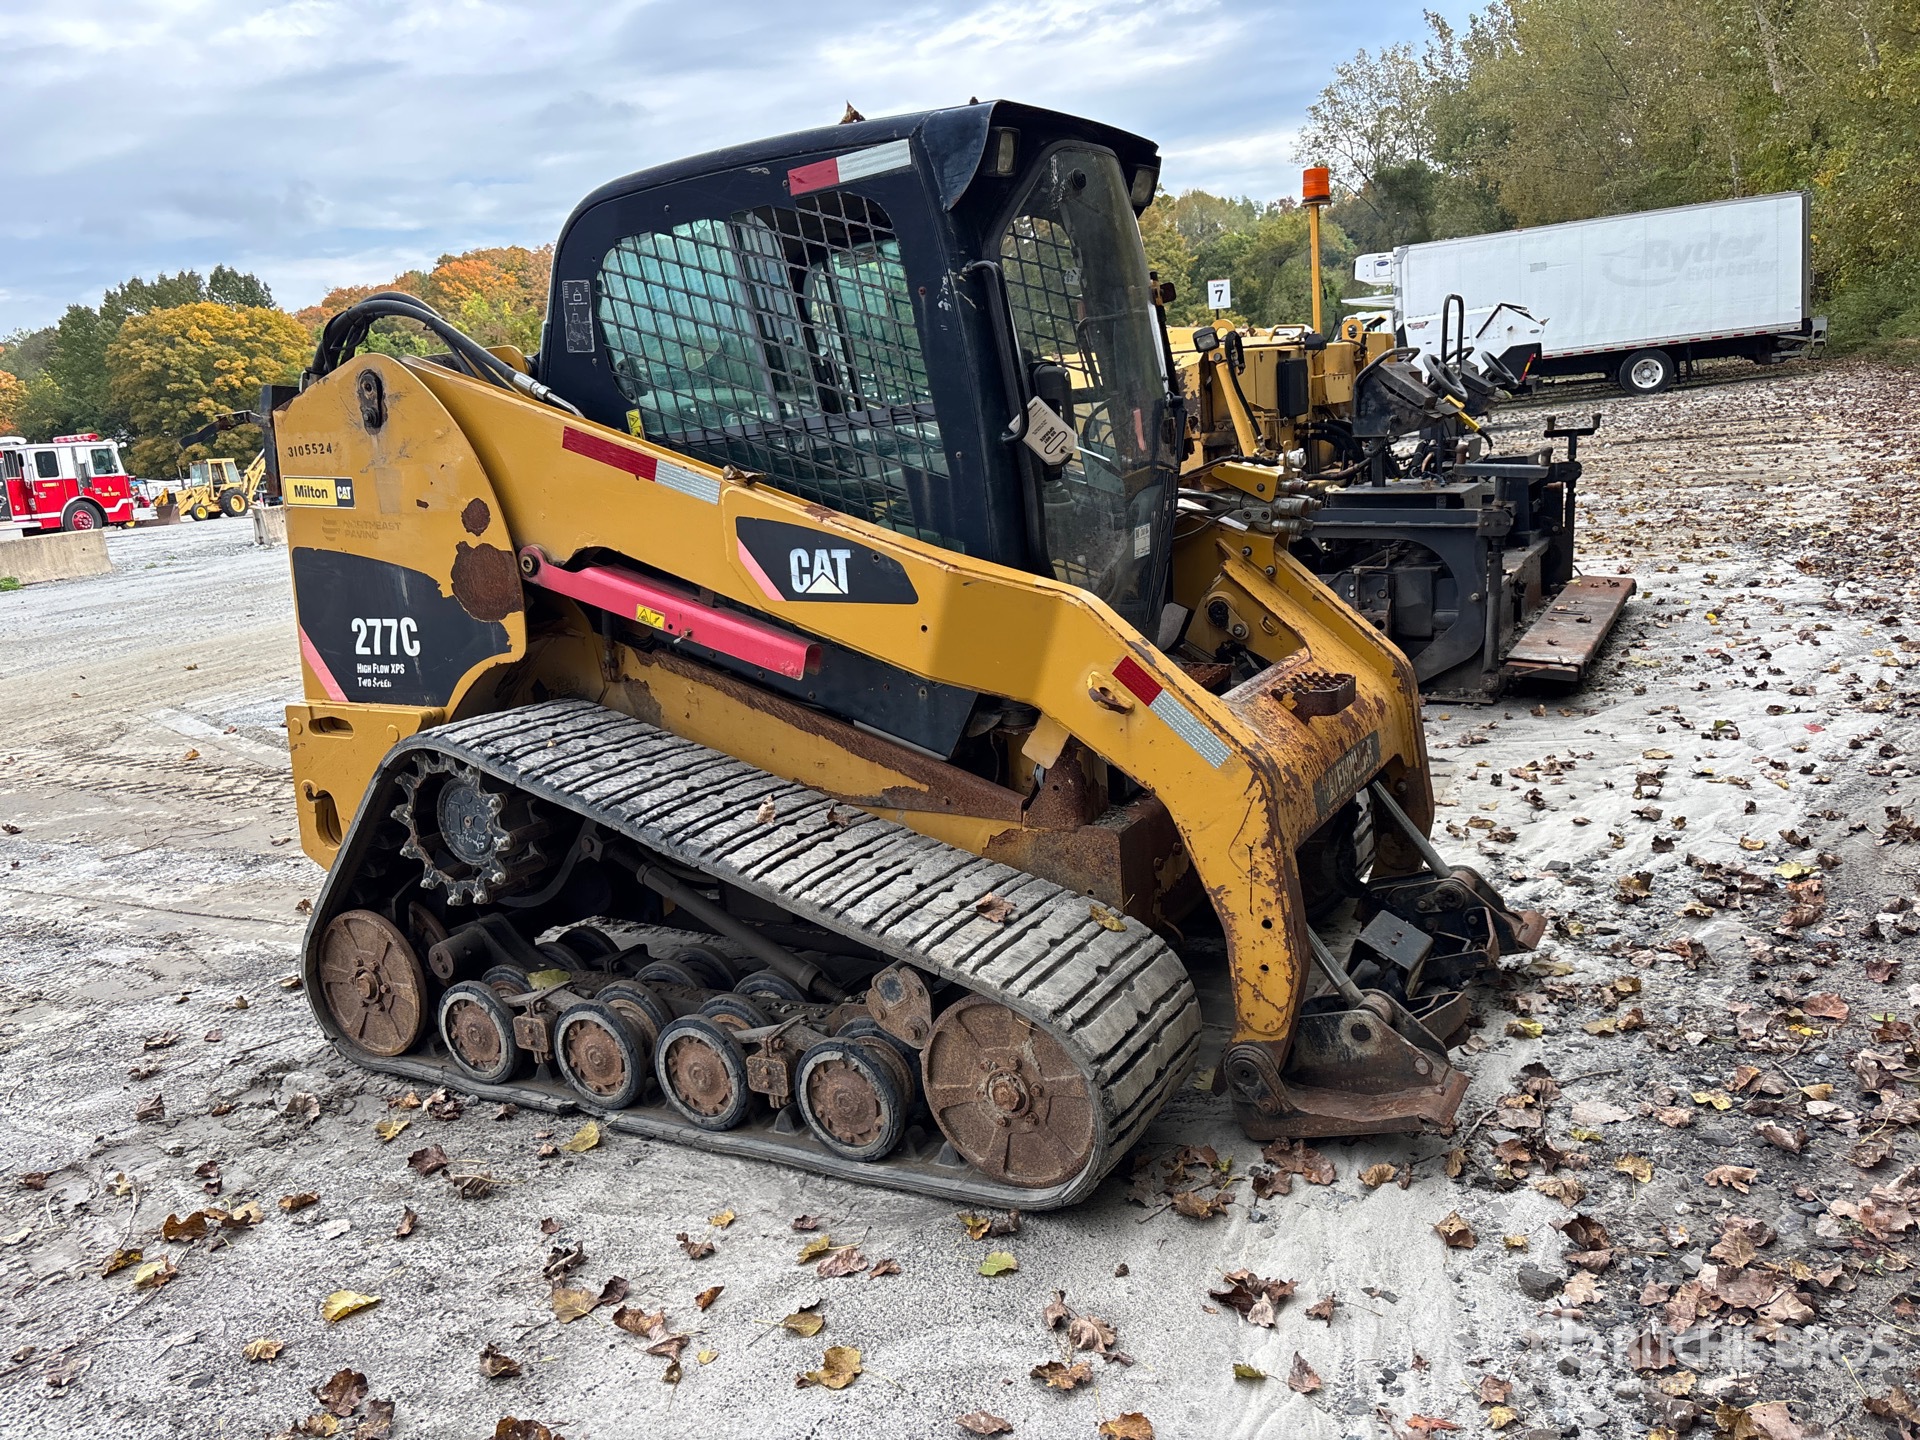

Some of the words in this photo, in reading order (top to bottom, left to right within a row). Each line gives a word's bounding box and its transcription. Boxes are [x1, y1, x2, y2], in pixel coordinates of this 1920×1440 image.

[1214, 289, 1224, 303] 7
[288, 443, 332, 457] 3105524
[294, 485, 329, 499] Milton
[336, 486, 352, 500] CAT
[789, 547, 851, 595] CAT
[351, 617, 421, 657] 277C
[390, 663, 405, 674] XPS
